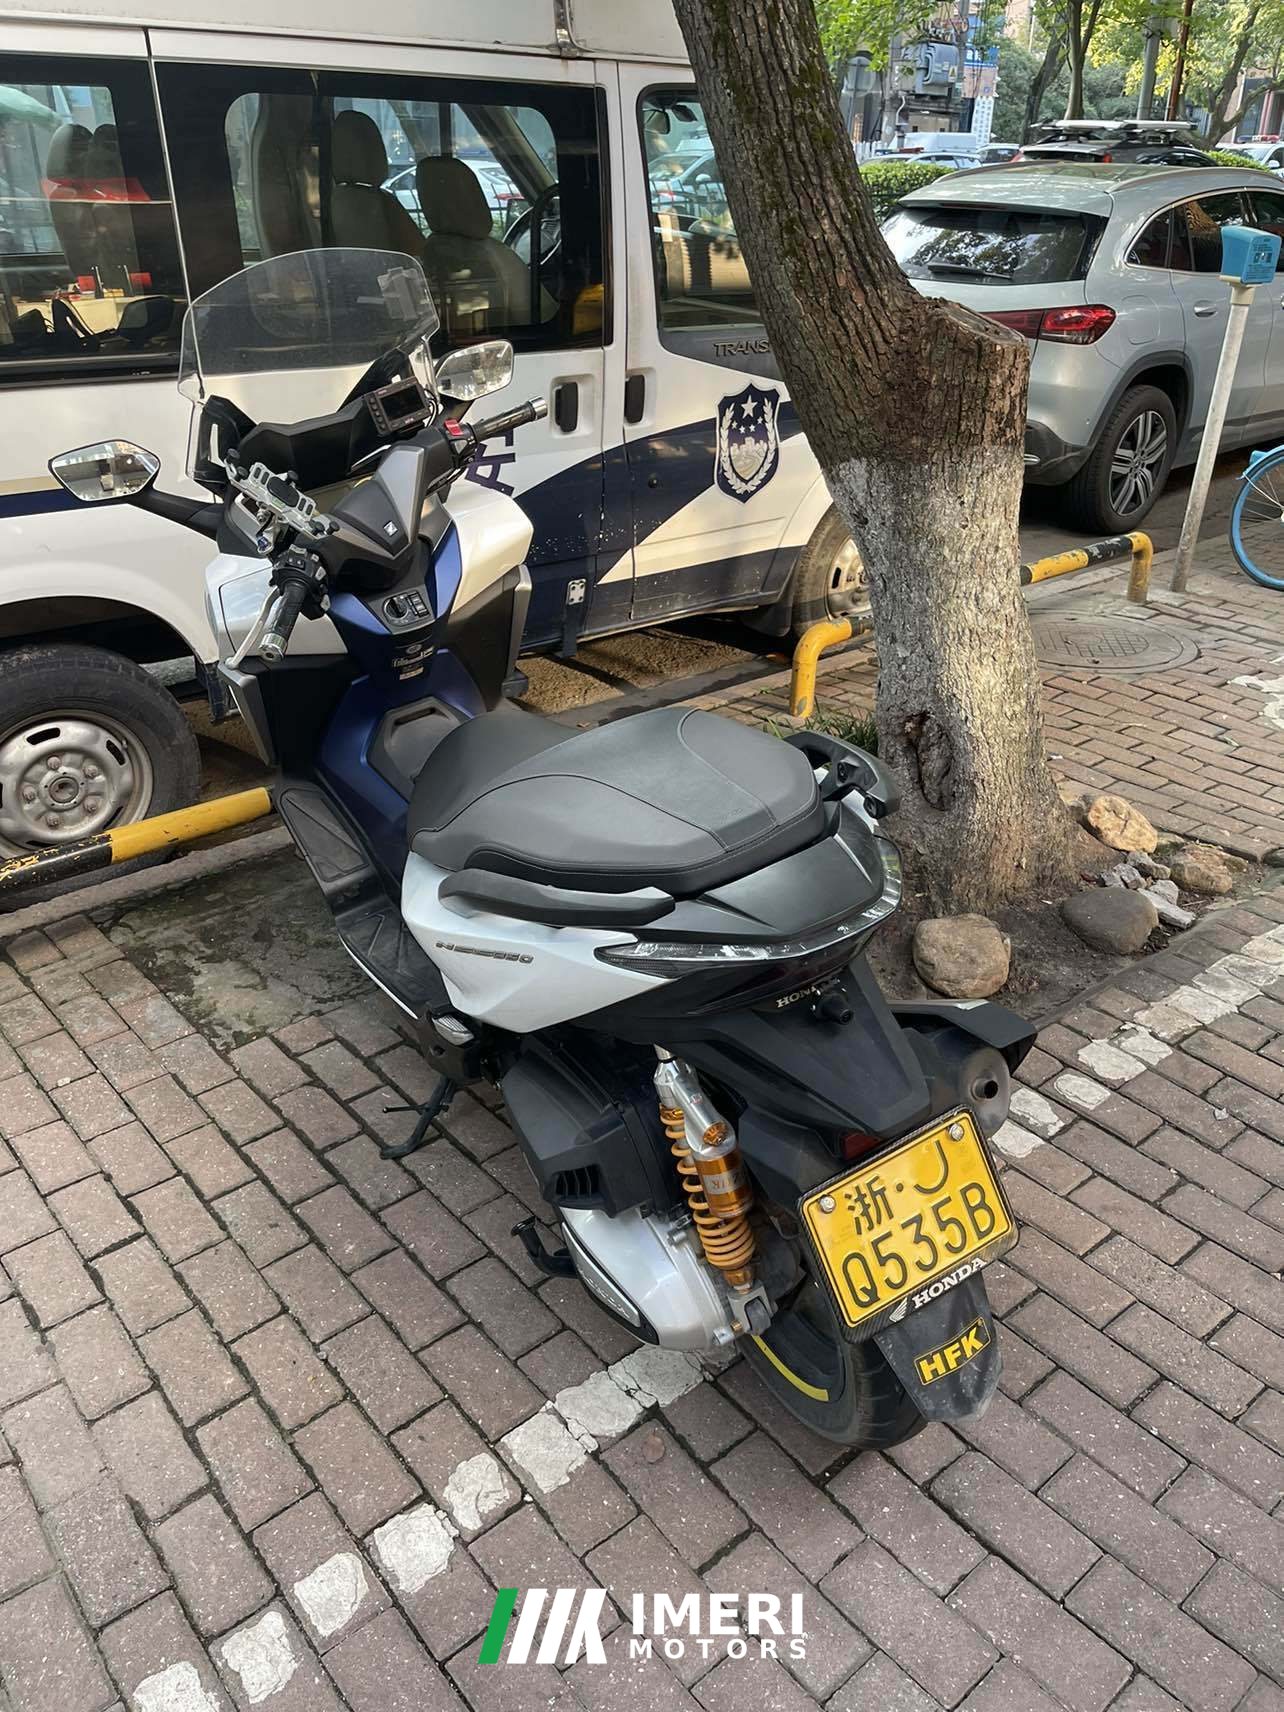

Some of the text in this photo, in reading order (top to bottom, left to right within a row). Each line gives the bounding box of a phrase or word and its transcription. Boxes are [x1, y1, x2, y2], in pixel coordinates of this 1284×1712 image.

[713, 338, 770, 357] TRANS
[842, 1181, 996, 1308] Q535B
[912, 1257, 987, 1309] HONDA
[919, 1327, 983, 1381] HFK
